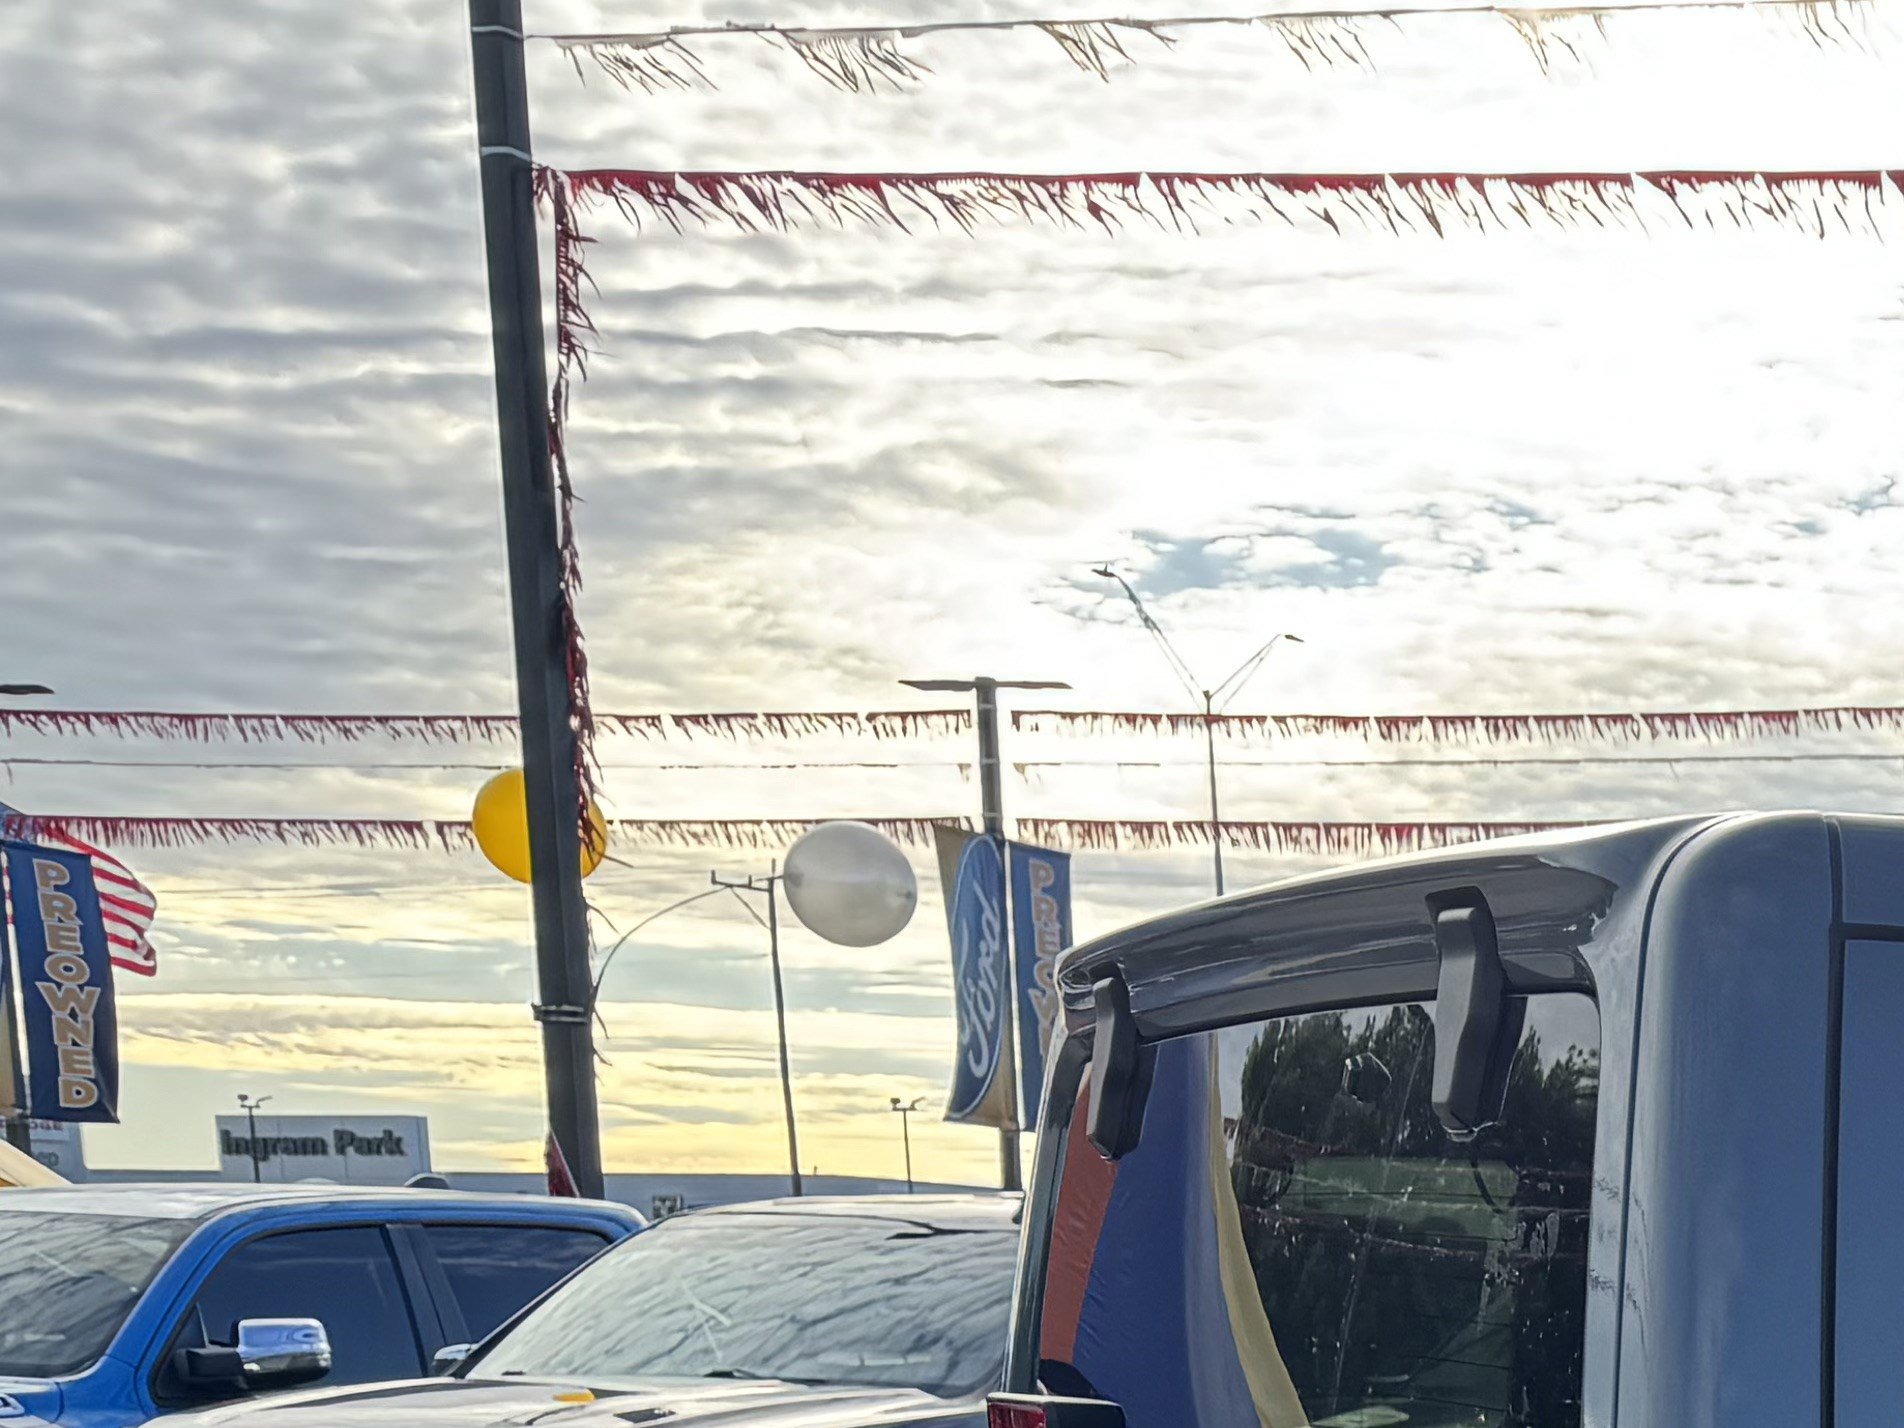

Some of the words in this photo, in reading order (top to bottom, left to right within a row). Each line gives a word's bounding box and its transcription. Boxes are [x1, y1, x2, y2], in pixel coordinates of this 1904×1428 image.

[32, 858, 101, 1108] PREOWNED
[961, 879, 1000, 1078] Ford
[221, 1129, 329, 1161] Ingram
[333, 1128, 407, 1157] Park
